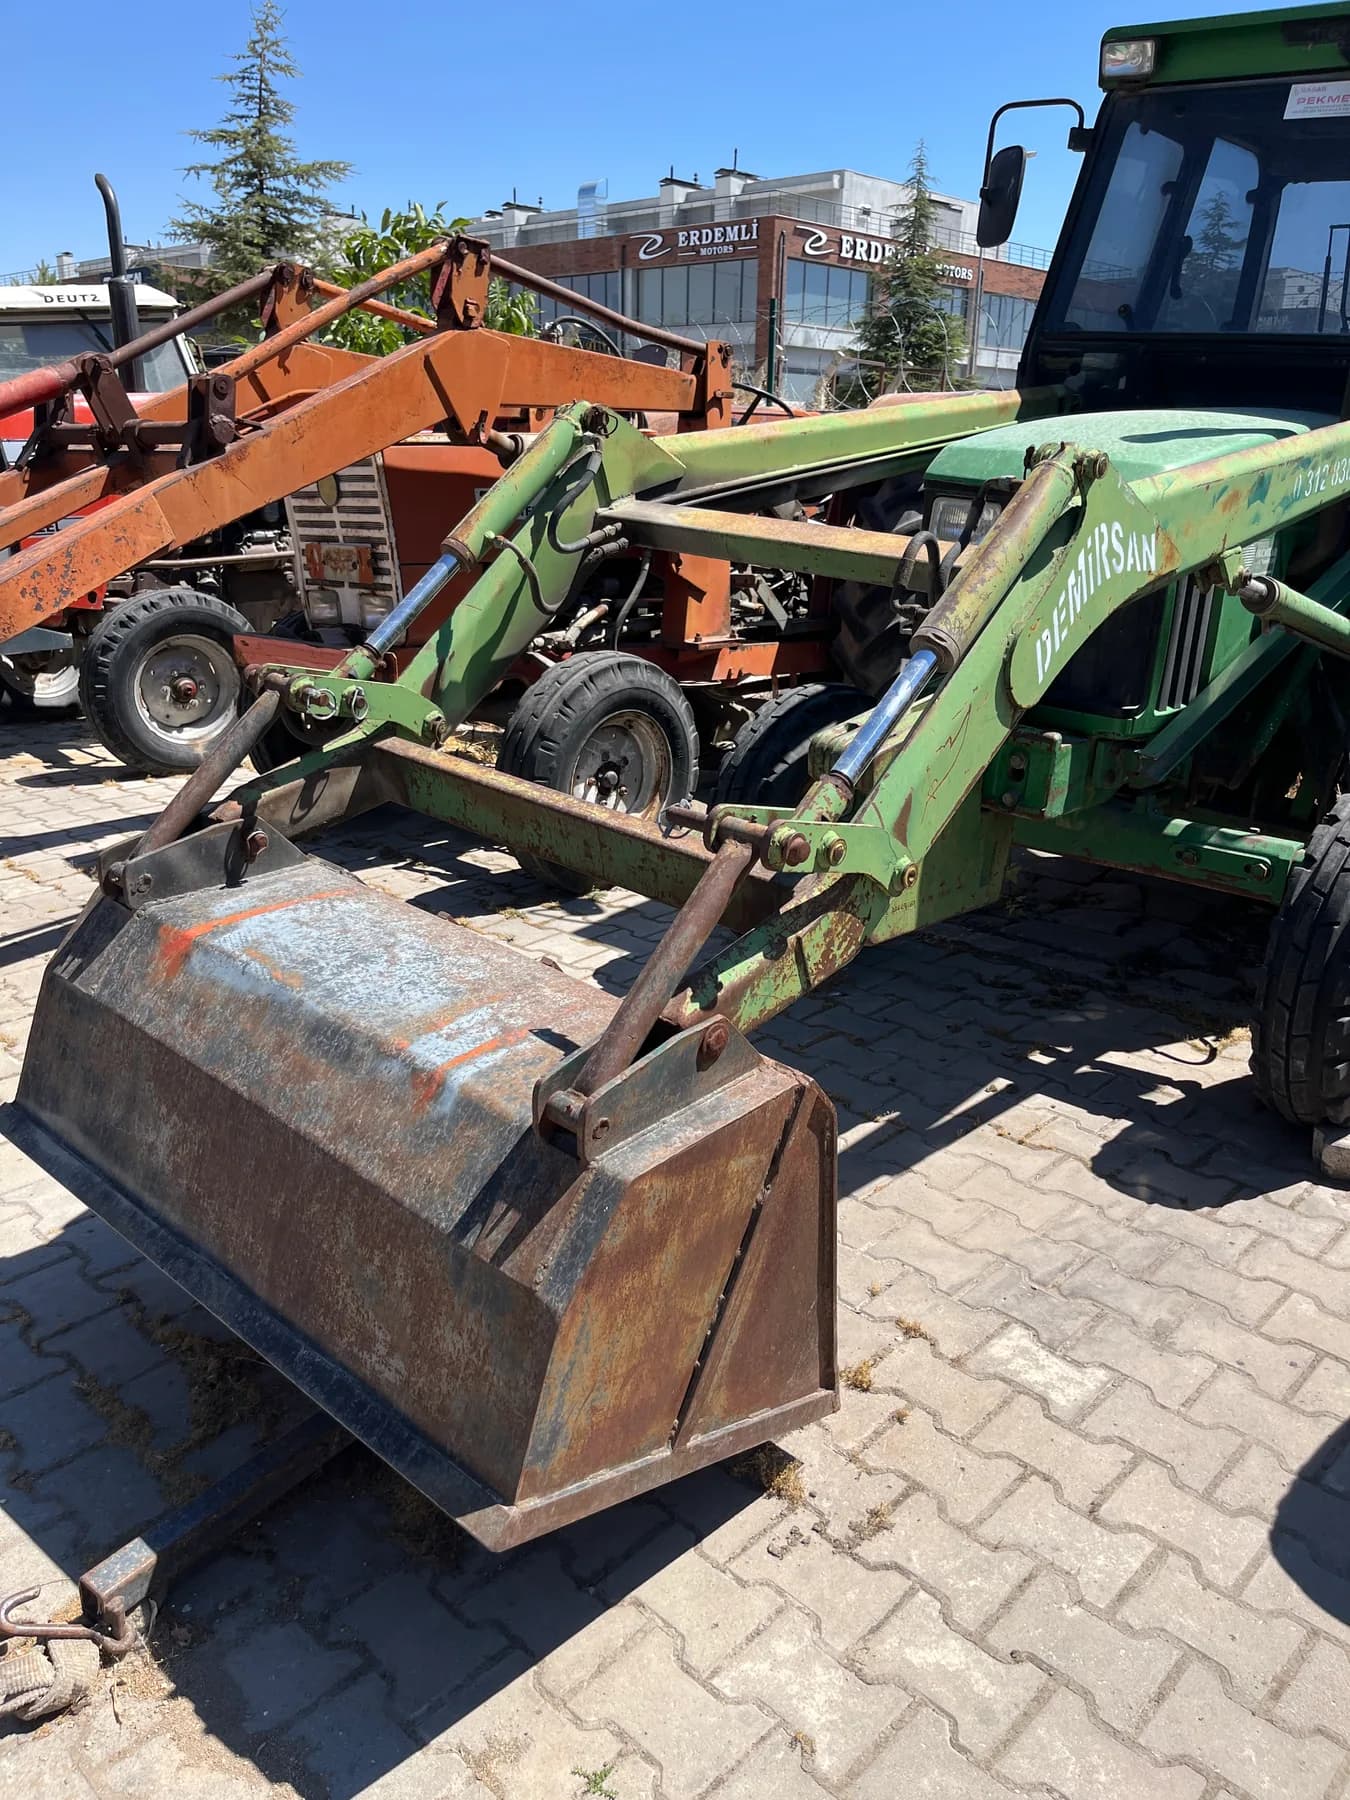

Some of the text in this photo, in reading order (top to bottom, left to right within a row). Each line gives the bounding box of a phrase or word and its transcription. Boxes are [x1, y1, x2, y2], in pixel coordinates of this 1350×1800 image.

[700, 245, 734, 256] MOTORS
[43, 294, 101, 303] DEUTZ
[1305, 463, 1329, 497] 312
